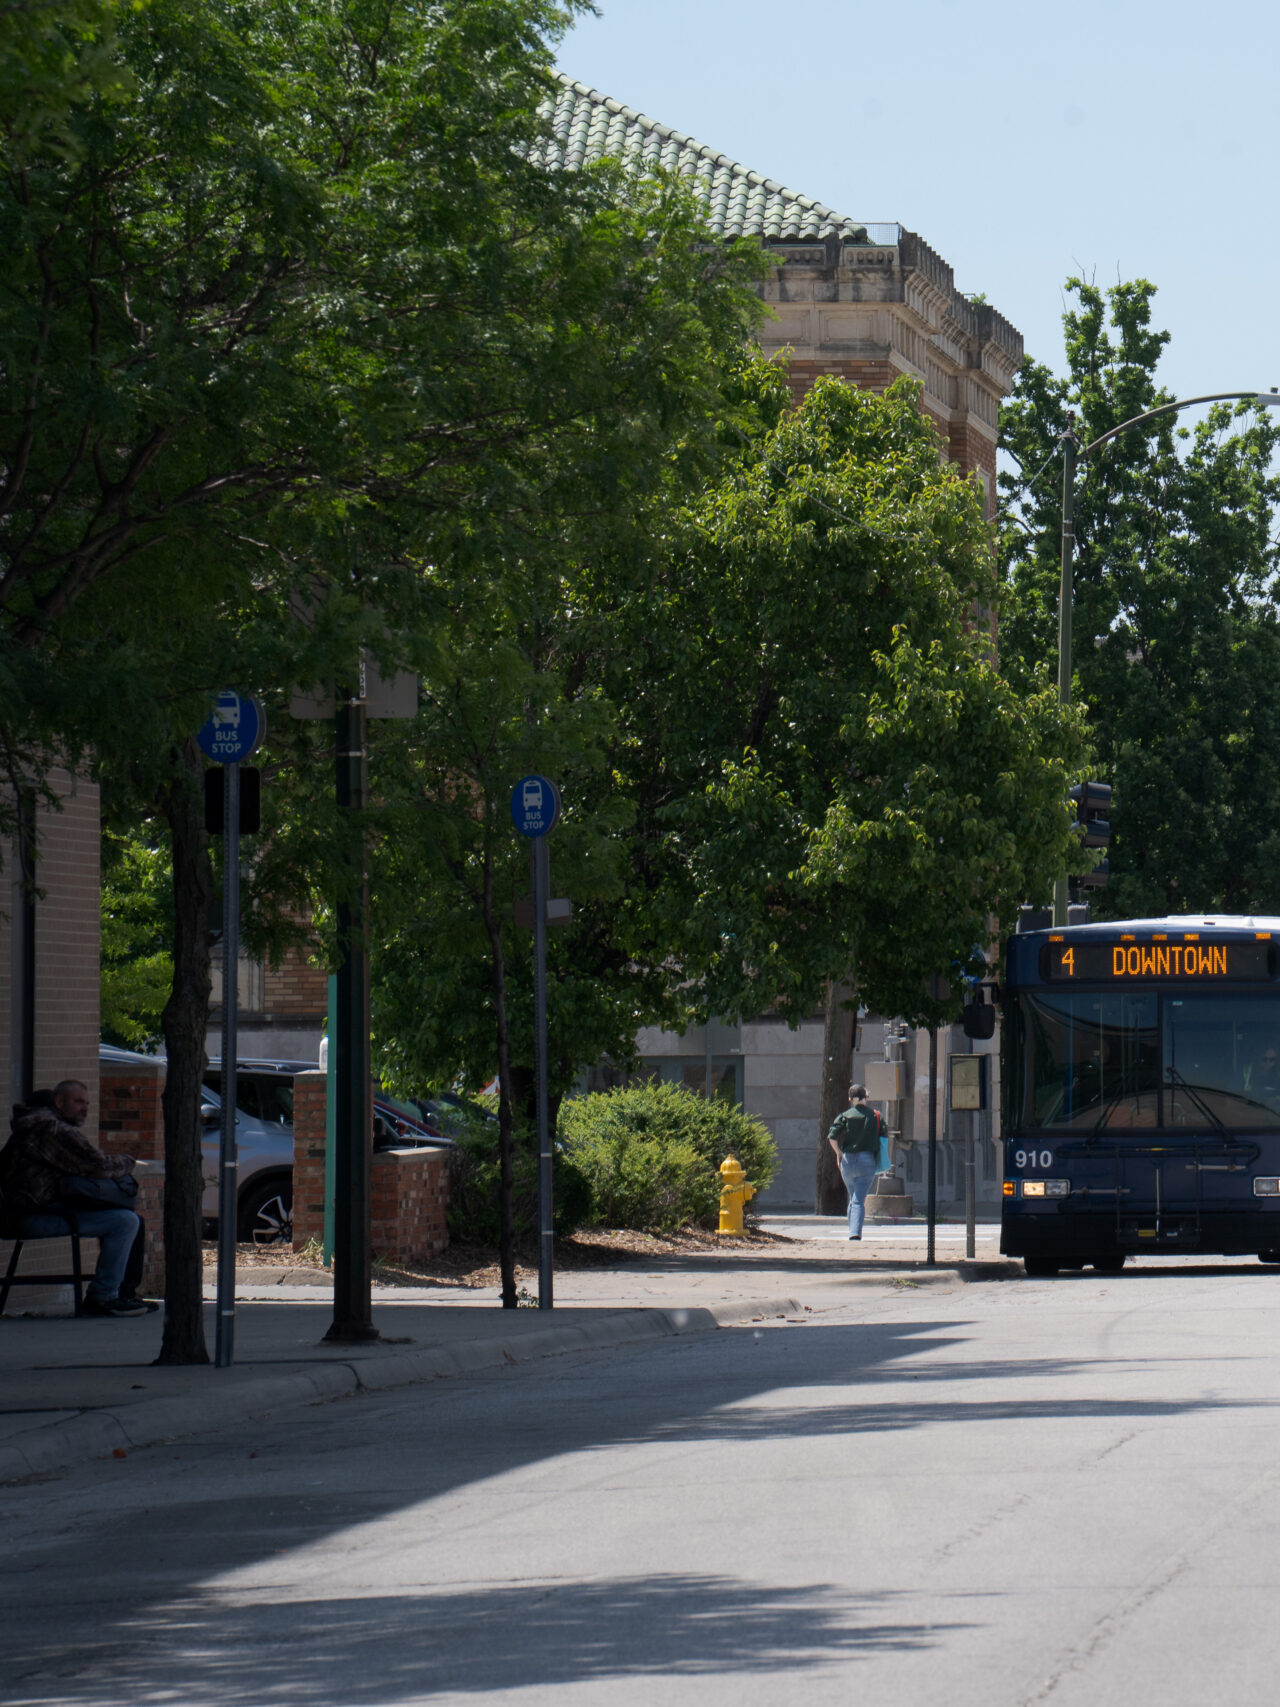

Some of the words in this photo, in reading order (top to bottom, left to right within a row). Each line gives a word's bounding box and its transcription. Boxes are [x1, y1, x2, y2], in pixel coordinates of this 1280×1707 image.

[215, 730, 239, 741] BUS
[211, 743, 242, 754] STOP
[525, 811, 542, 821] BUS
[523, 821, 545, 831] STOP
[1061, 947, 1075, 976] 4
[1113, 946, 1227, 976] DOWNTOWN
[1015, 1149, 1052, 1168] 910
